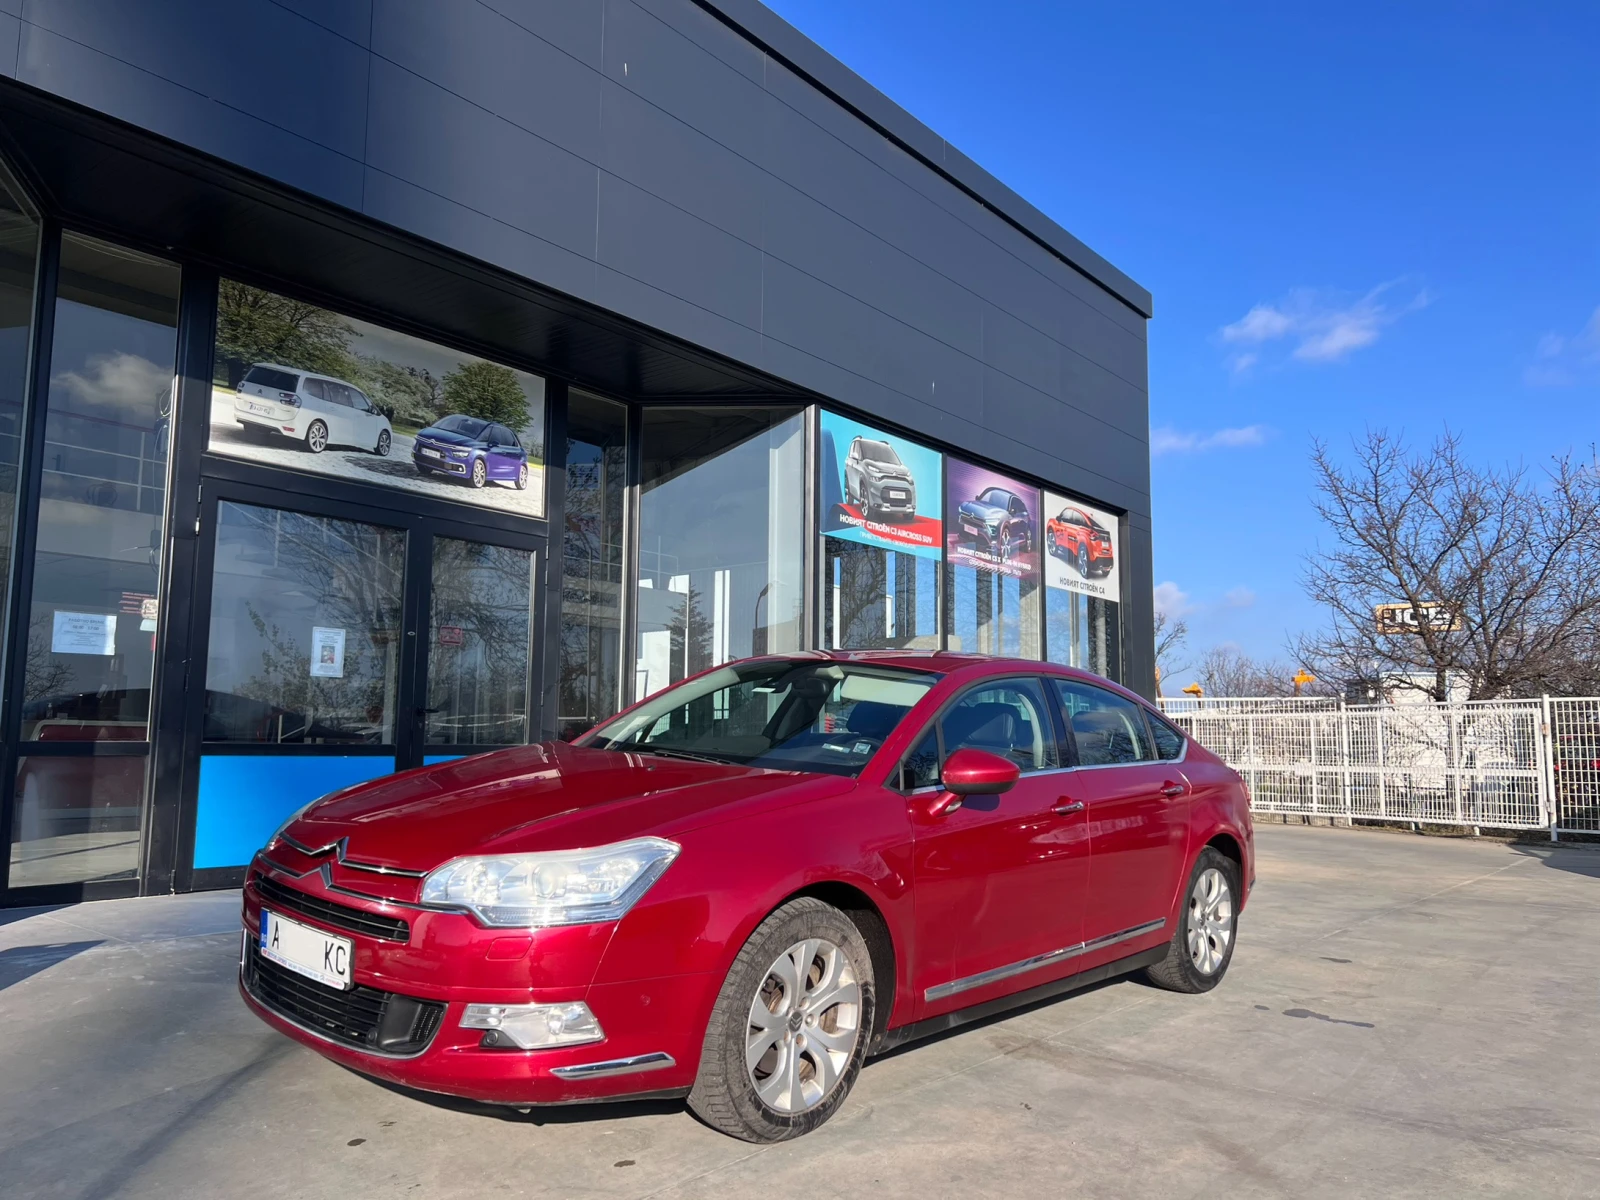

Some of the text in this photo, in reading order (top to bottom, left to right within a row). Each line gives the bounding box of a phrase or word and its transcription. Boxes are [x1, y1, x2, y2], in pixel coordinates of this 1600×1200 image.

[839, 513, 866, 527] НОВИЯТ
[866, 521, 890, 534] CITROËN
[897, 529, 922, 542] AIRCROSS
[923, 535, 933, 544] SUV
[1059, 576, 1079, 589] НОВИЯТ
[1079, 582, 1098, 593] CITROËN
[272, 920, 279, 950] A
[324, 940, 346, 976] KC
